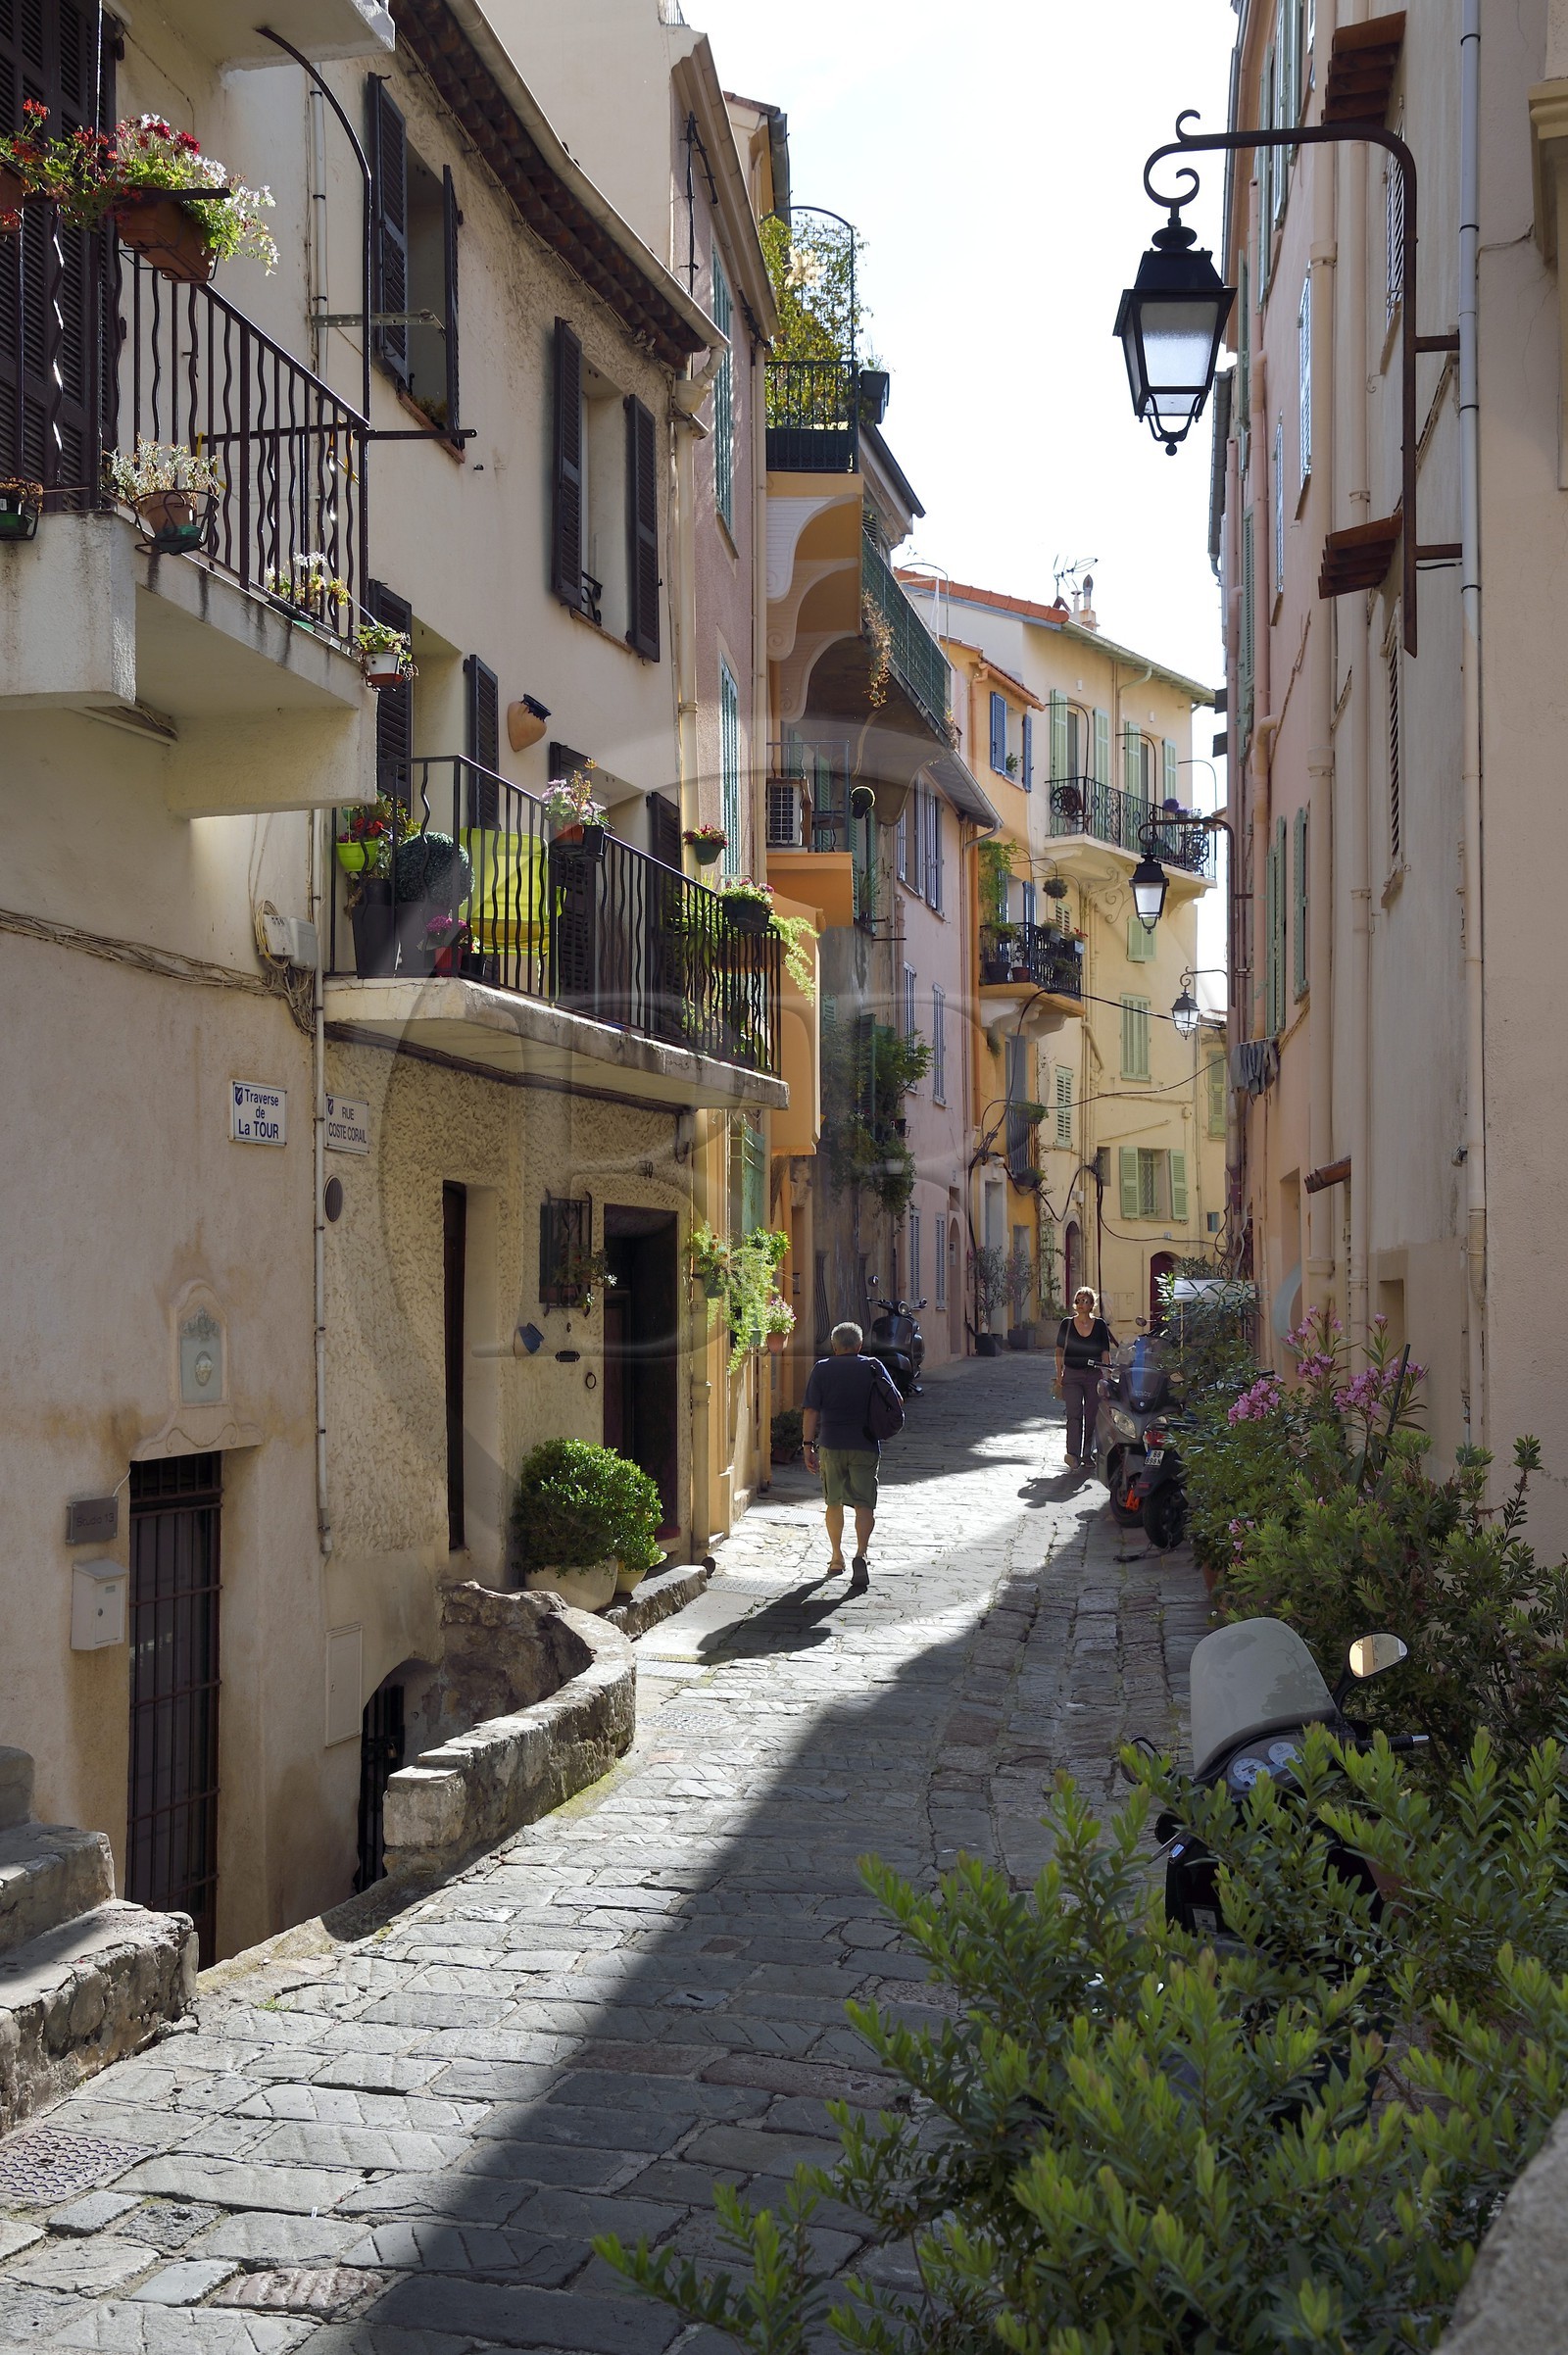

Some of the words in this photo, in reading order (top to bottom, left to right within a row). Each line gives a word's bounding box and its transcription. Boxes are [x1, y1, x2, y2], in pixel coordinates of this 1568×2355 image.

[245, 1089, 279, 1106] Traverse
[256, 1105, 266, 1119] de
[342, 1106, 355, 1120] RUE
[239, 1118, 251, 1136] La
[254, 1121, 279, 1139] TOUR
[329, 1122, 347, 1139] COSTE
[348, 1126, 368, 1144] CORAIL
[76, 1516, 103, 1527] Studio
[105, 1512, 115, 1523] 13
